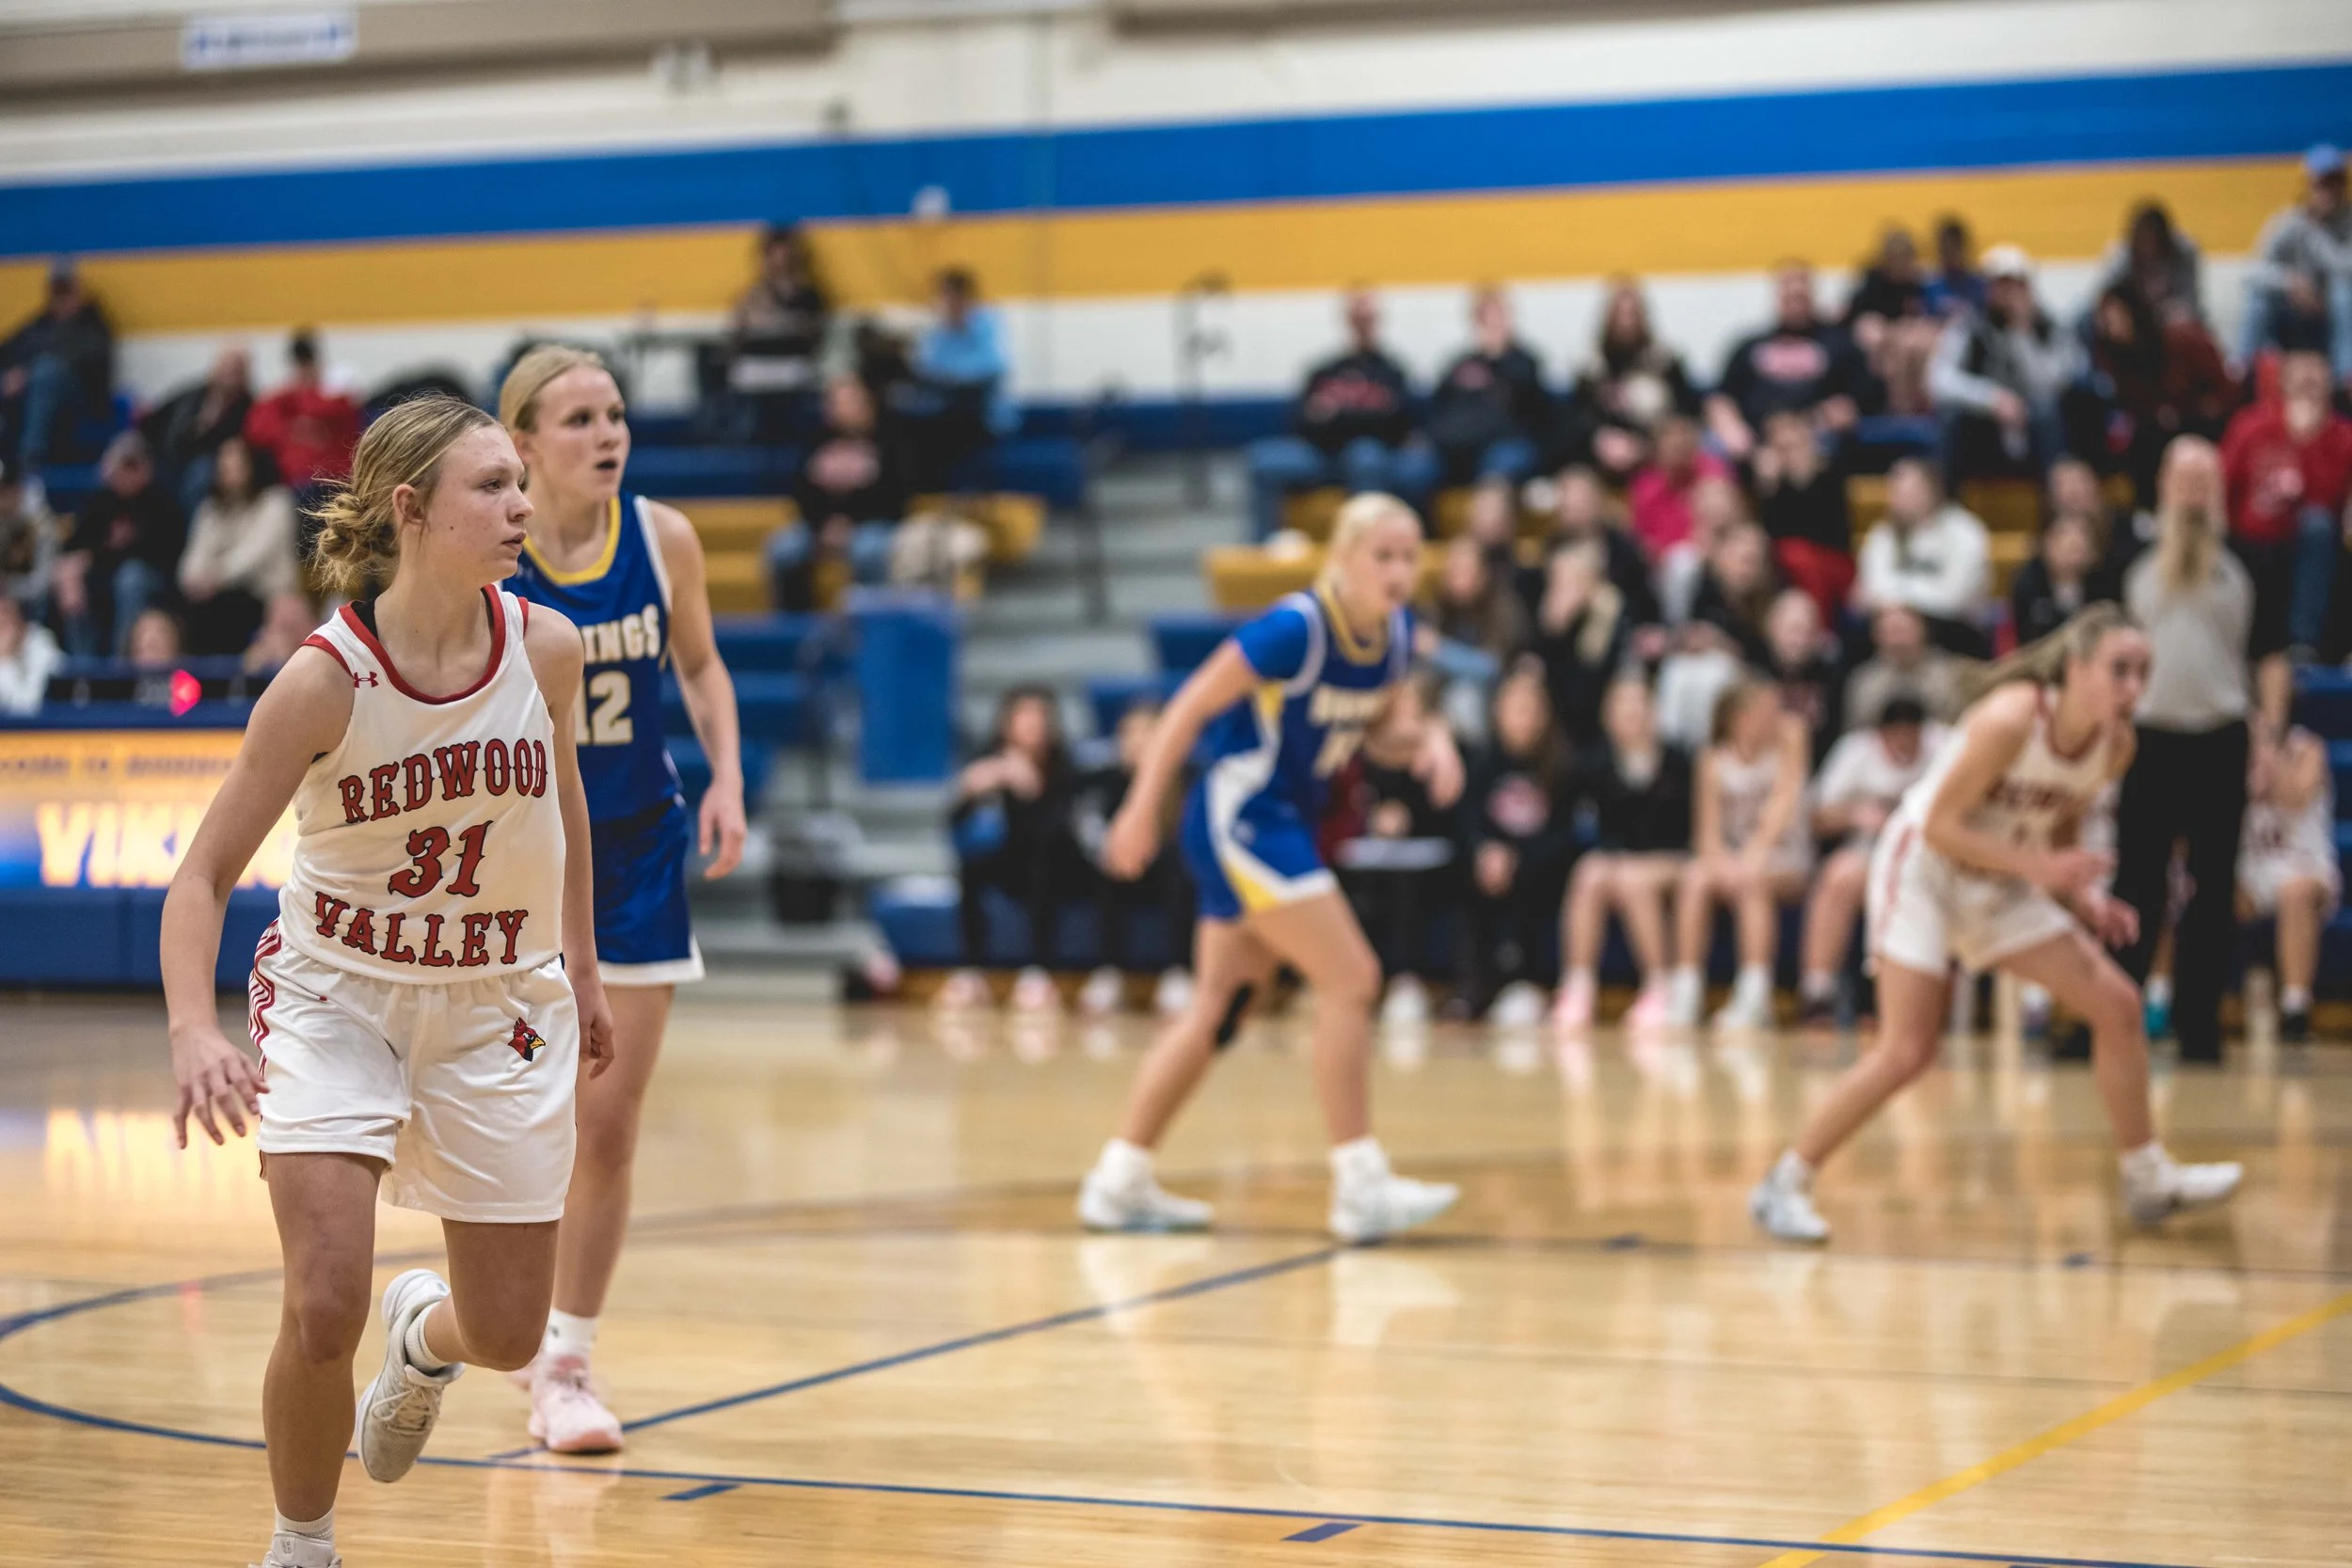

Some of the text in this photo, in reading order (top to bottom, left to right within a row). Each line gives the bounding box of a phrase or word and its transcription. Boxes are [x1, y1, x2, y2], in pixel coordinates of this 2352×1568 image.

[580, 603, 660, 665] INGS
[573, 671, 633, 746] 12
[338, 738, 548, 824] REDWOOD
[388, 820, 495, 897] 31
[314, 891, 529, 967] VALLEY
